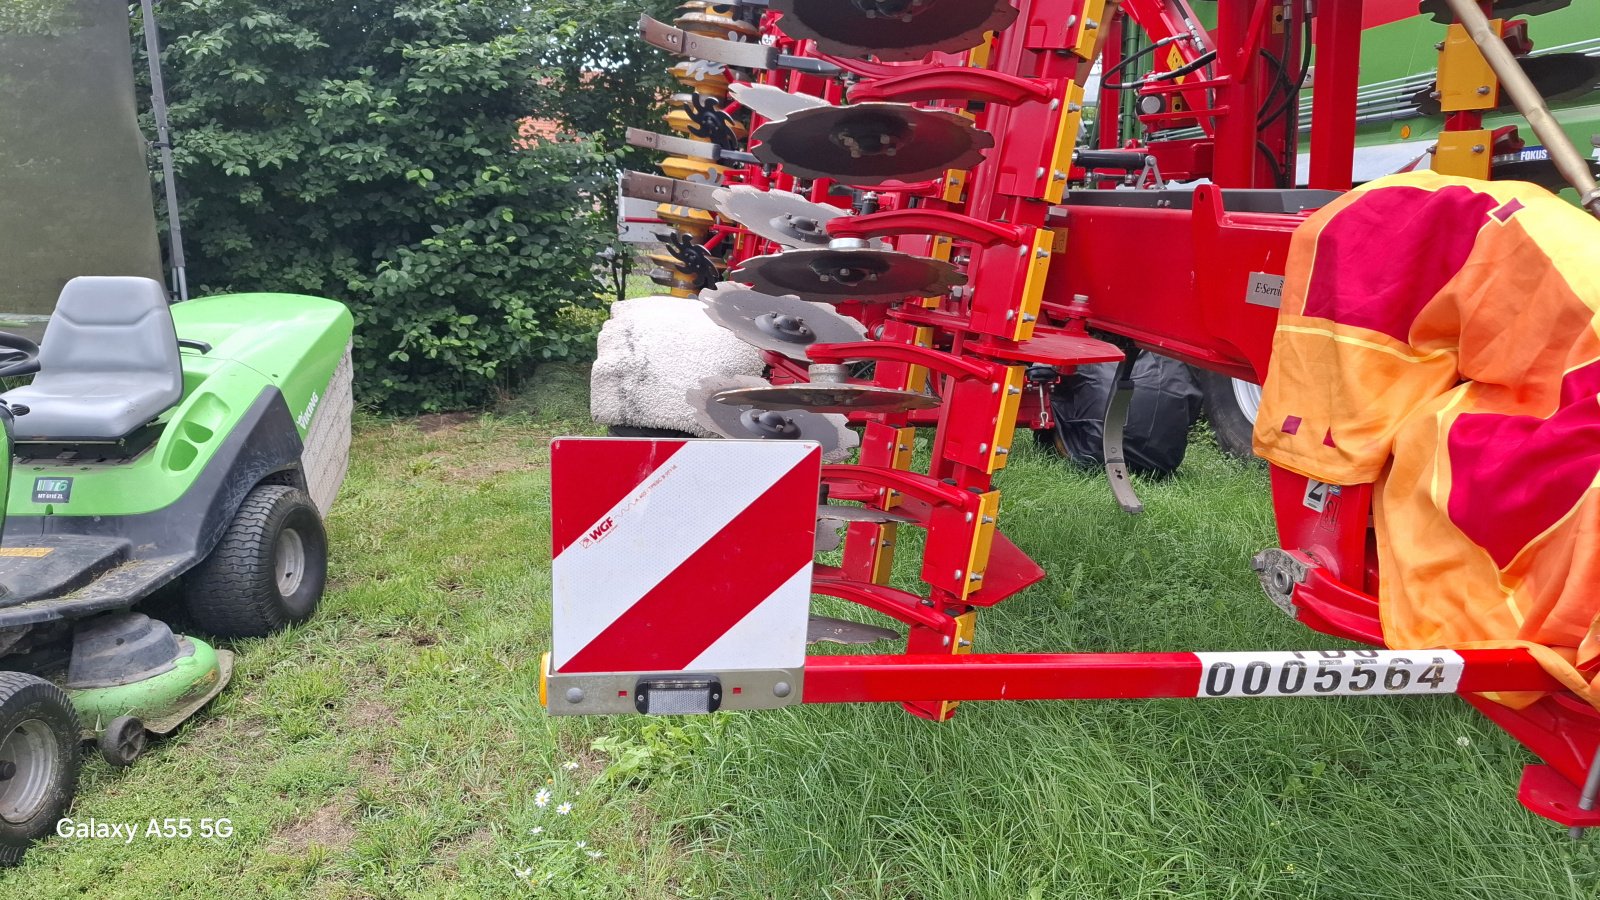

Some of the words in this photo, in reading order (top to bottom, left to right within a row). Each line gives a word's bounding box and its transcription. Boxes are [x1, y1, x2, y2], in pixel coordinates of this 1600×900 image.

[1520, 149, 1548, 161] FOKUS
[1254, 282, 1283, 297] E-Servi
[298, 391, 319, 430] VIKING
[589, 516, 614, 541] WGF
[1205, 657, 1445, 697] 0005564
